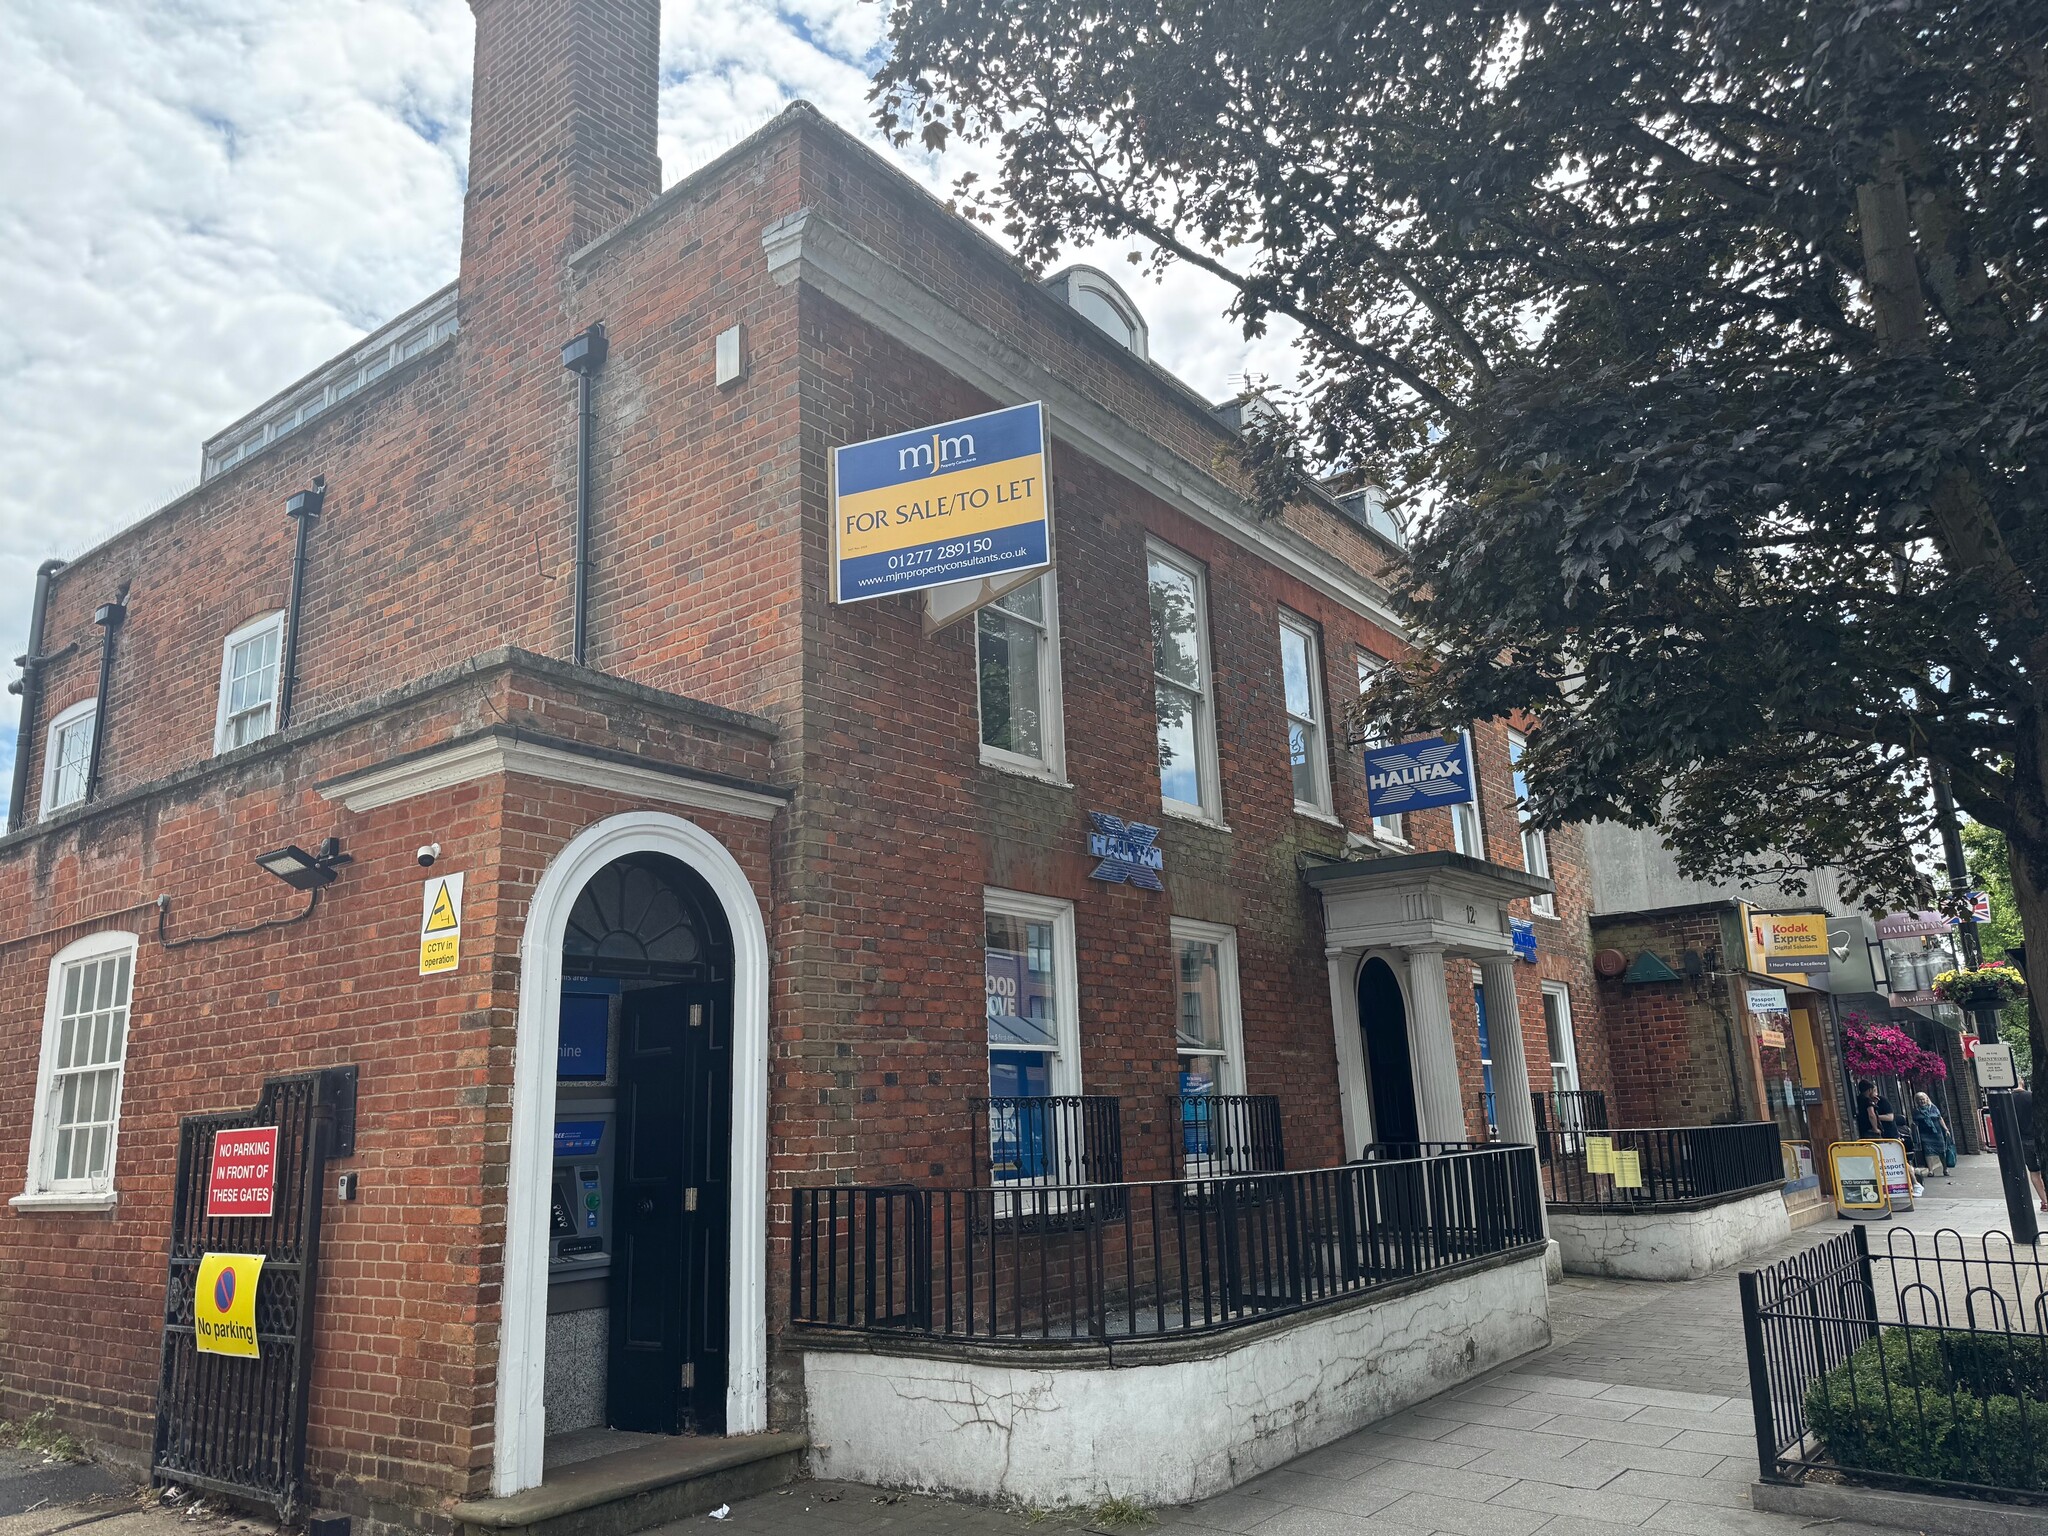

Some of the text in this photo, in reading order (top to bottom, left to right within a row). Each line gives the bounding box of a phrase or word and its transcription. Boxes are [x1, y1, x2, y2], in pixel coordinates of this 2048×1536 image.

[846, 477, 1036, 534] FOR SALE/TO LET
[888, 537, 992, 570] 01277 289150
[1369, 759, 1464, 791] HALIFAX
[1090, 833, 1163, 871] HALIFAX
[1466, 904, 1476, 925] 12
[1772, 923, 1808, 933] Kodak
[1883, 921, 1944, 934] DAIRYMAN
[427, 941, 453, 953] CCTV in
[1511, 930, 1538, 950] ALIFAX
[1773, 934, 1817, 945] Express
[424, 954, 455, 968] operation
[987, 975, 1016, 997] OOD
[988, 996, 1016, 1017] OVE
[220, 1142, 270, 1157] NO PARKING
[216, 1165, 269, 1179] IN FRONT OF
[212, 1187, 269, 1202] THESE GATES
[198, 1317, 254, 1345] No parking
